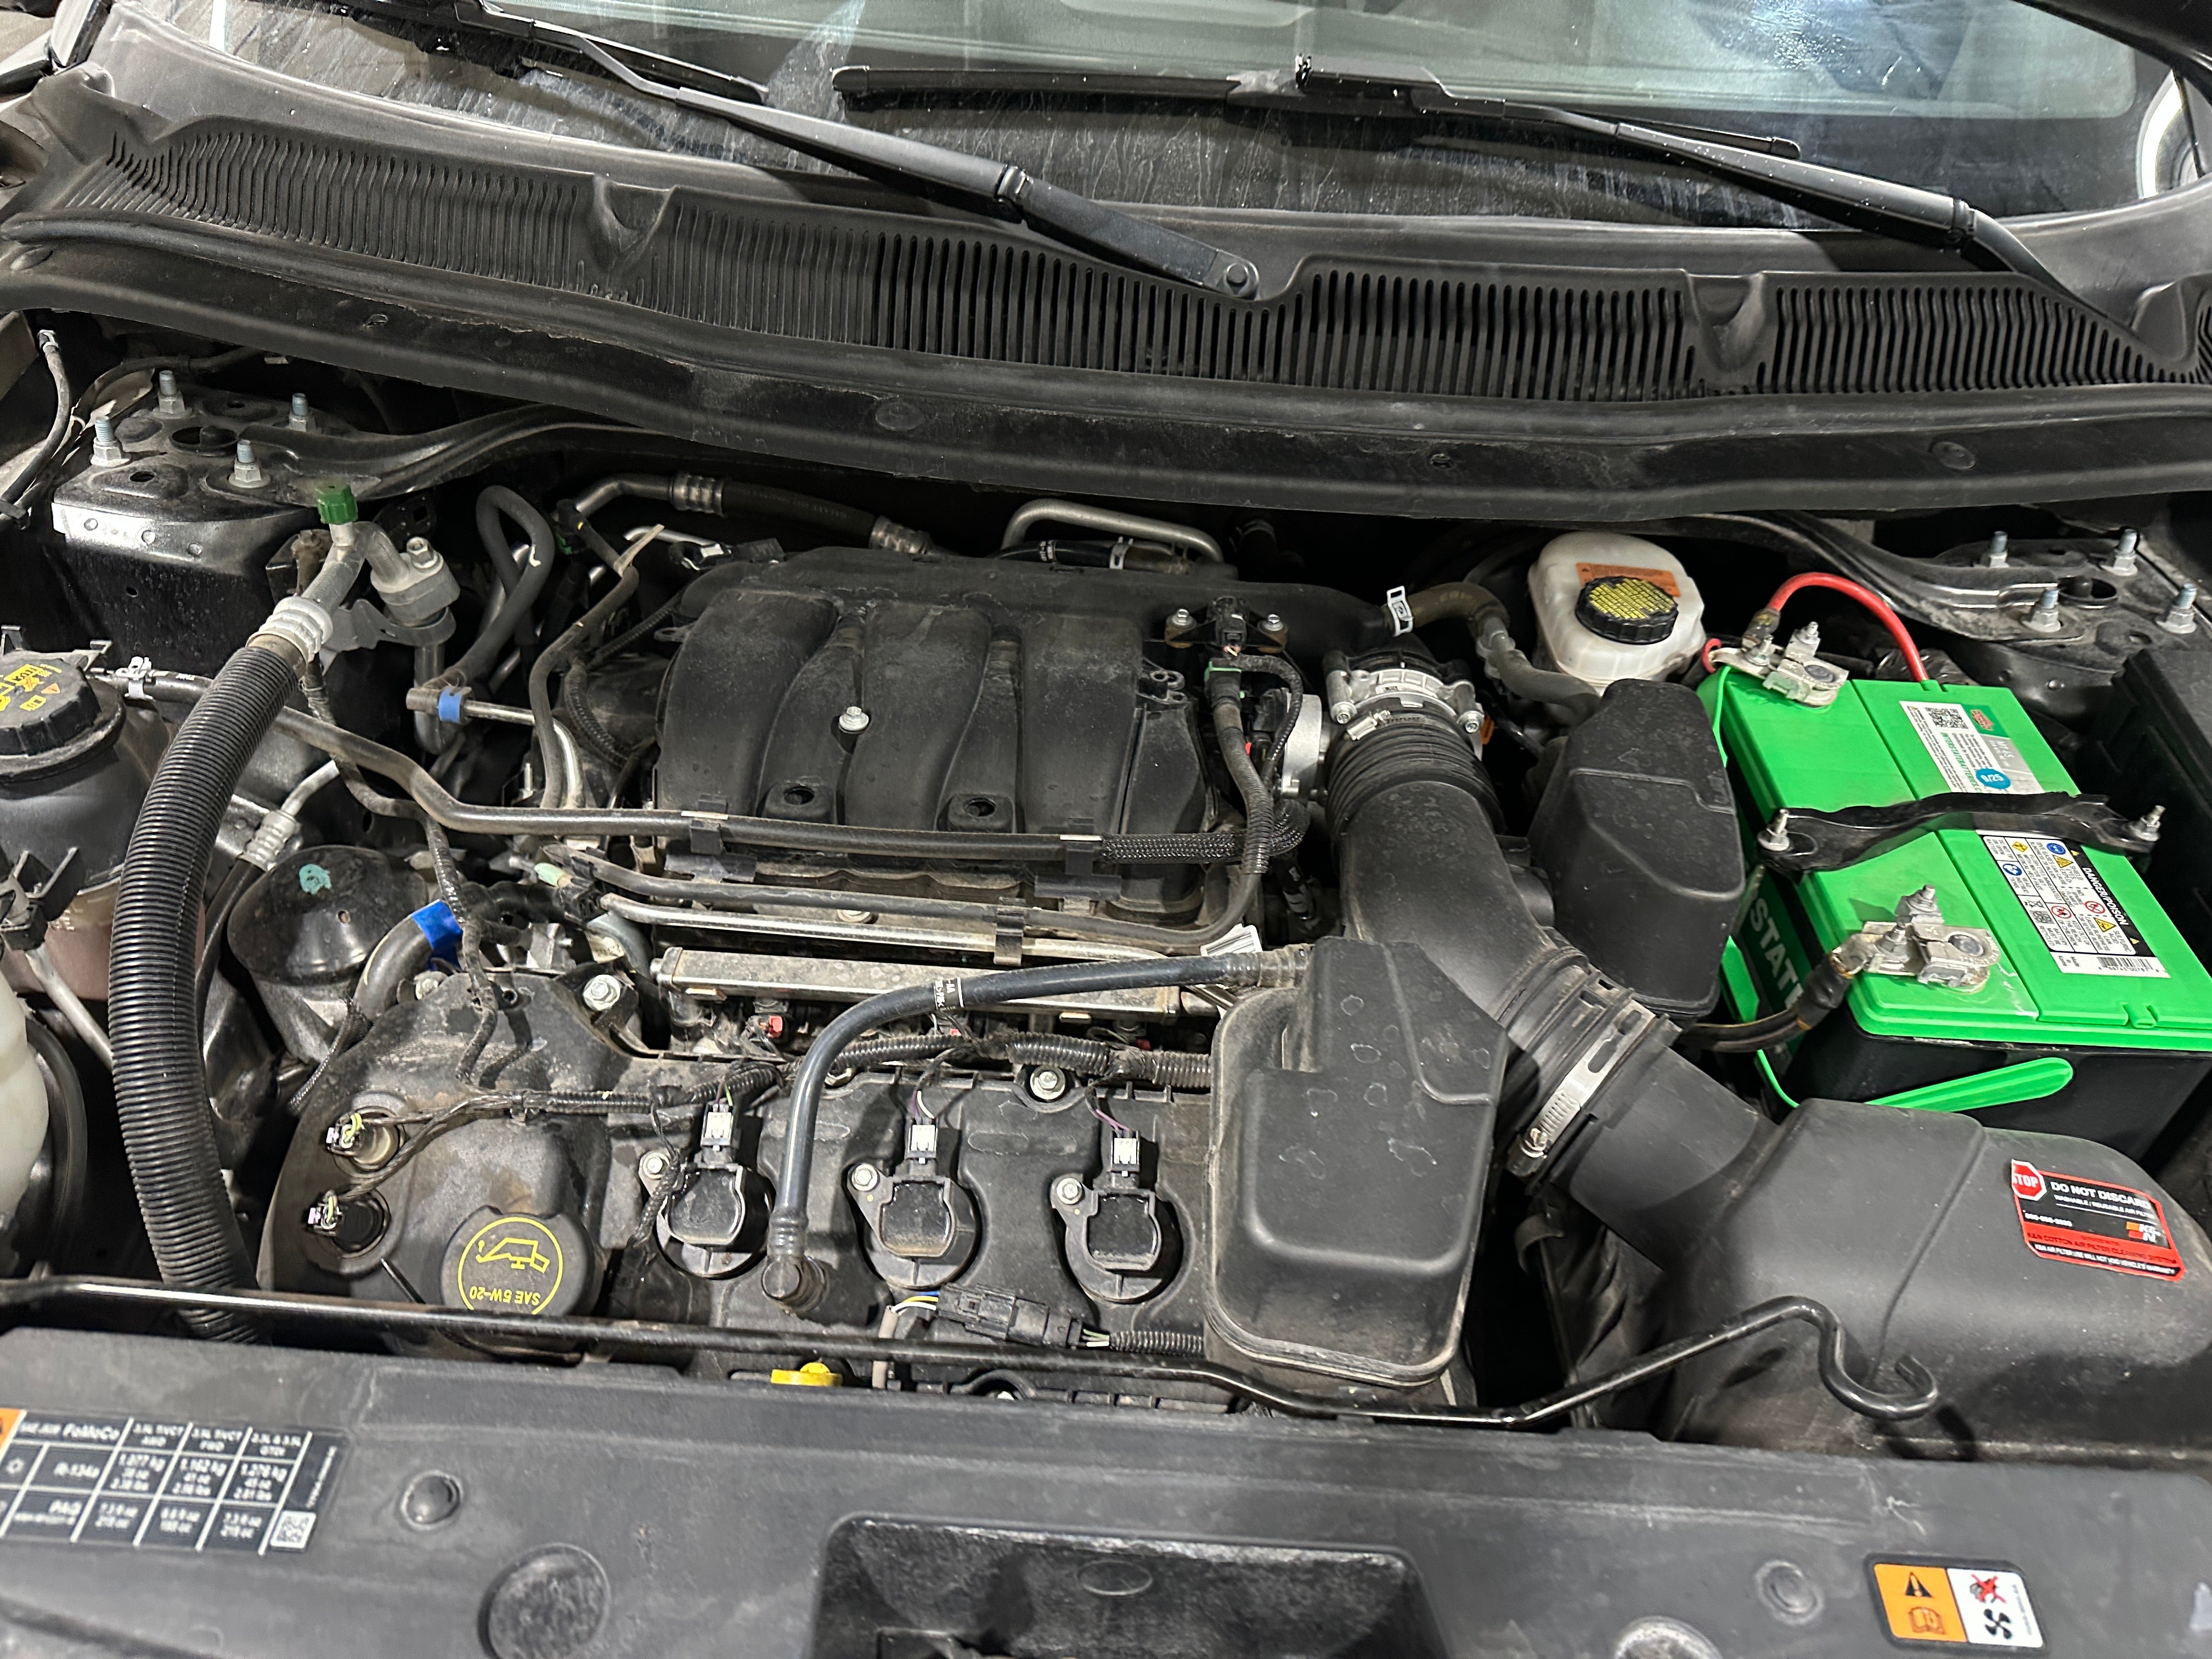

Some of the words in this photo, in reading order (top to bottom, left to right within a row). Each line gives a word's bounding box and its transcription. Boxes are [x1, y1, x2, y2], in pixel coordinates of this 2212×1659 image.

[1980, 773, 2004, 782] 9/25
[2082, 867, 2129, 926] DANGER/POISON
[2050, 1181, 2069, 1193] DO
[2070, 1185, 2096, 1198] NOT
[2098, 1189, 2151, 1209] DISCARD
[469, 1286, 511, 1304] 5W-20
[514, 1290, 540, 1306] SAE
[63, 1423, 120, 1441] FoMoCo
